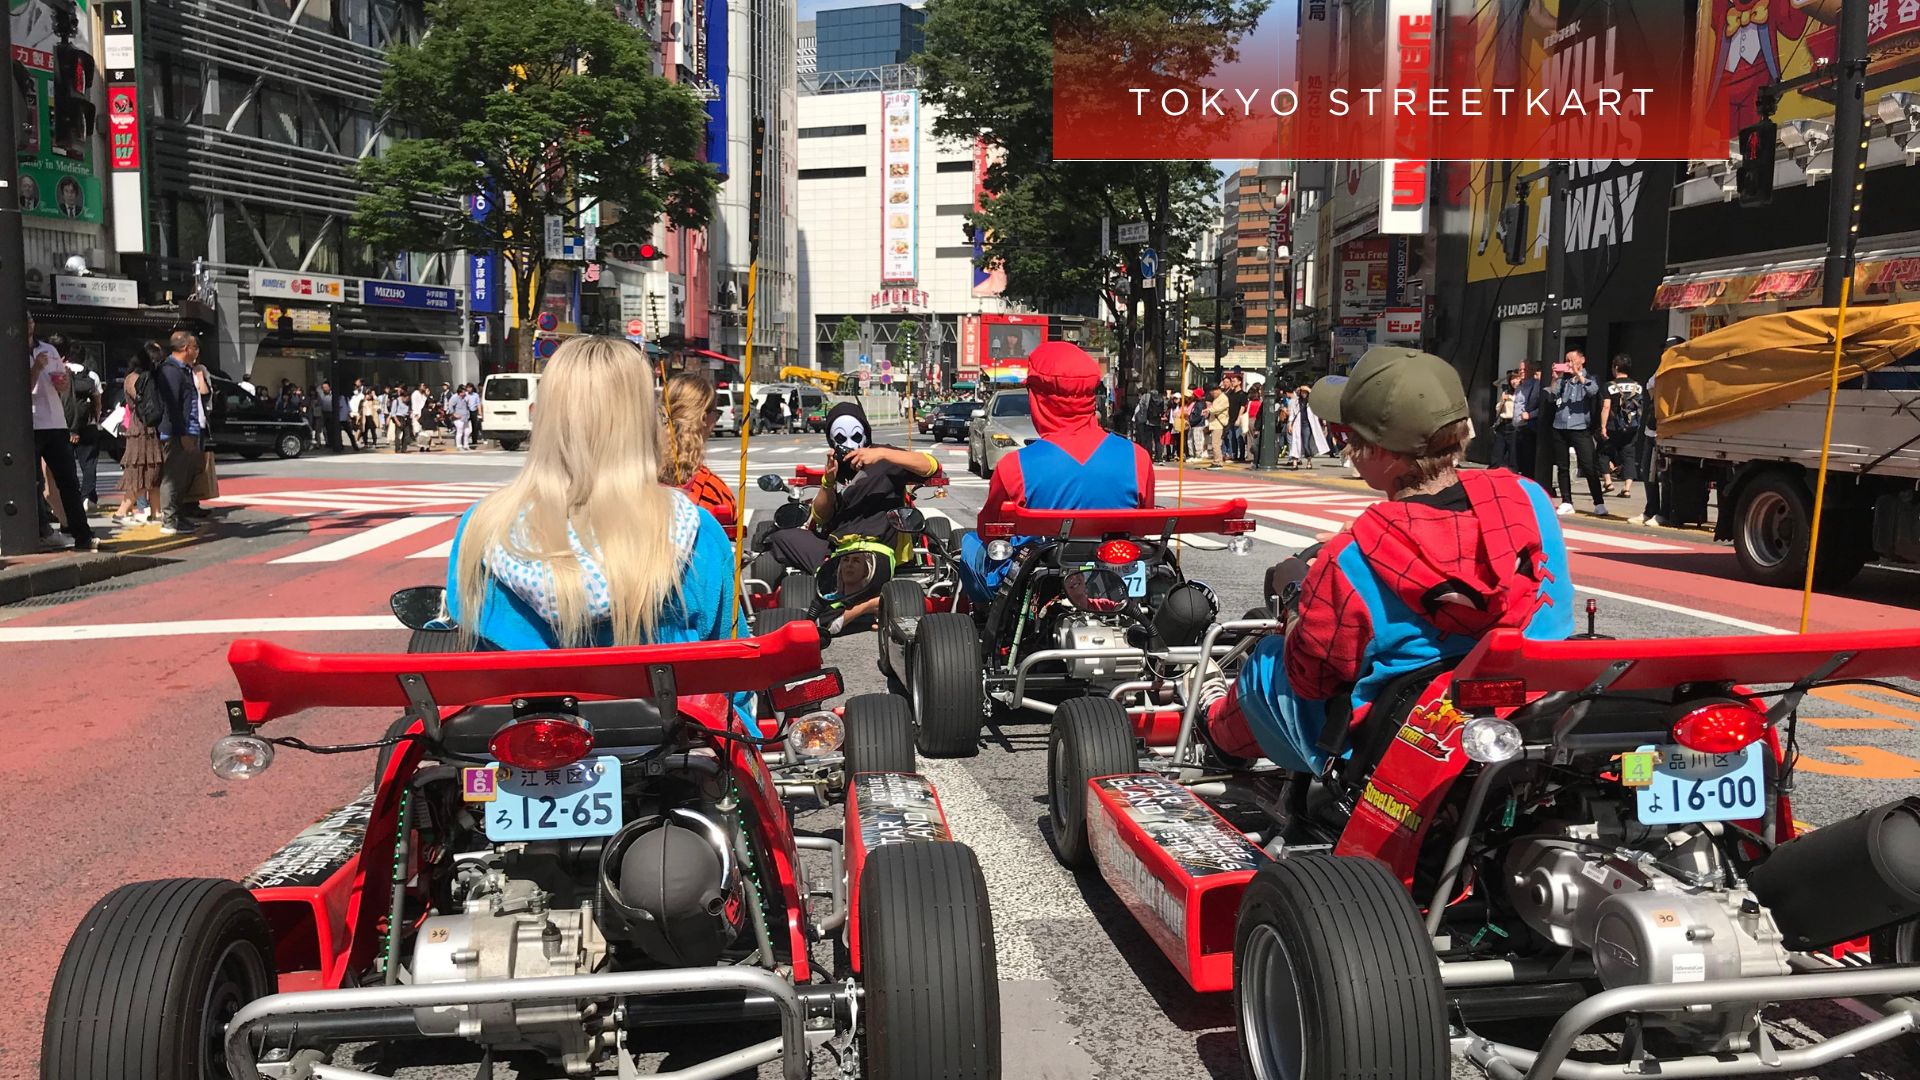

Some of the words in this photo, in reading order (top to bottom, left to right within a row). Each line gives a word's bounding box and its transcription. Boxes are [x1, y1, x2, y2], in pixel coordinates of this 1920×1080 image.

[1308, 0, 1326, 21] 局
[56, 160, 90, 176] Medicine
[1565, 171, 1643, 253] WAY
[1349, 251, 1366, 260] Tax
[1367, 250, 1389, 260] Free
[374, 286, 406, 299] MIZUHO
[871, 288, 930, 309] MAGNET
[1508, 302, 1538, 316] UNDER
[1540, 297, 1583, 313] AOUR
[1669, 753, 1729, 770] 品川区
[521, 768, 583, 786] 江東区
[1648, 793, 1663, 813] よ
[1672, 775, 1756, 812] 16-00
[495, 809, 513, 830] ろ
[522, 792, 613, 829] 12-65
